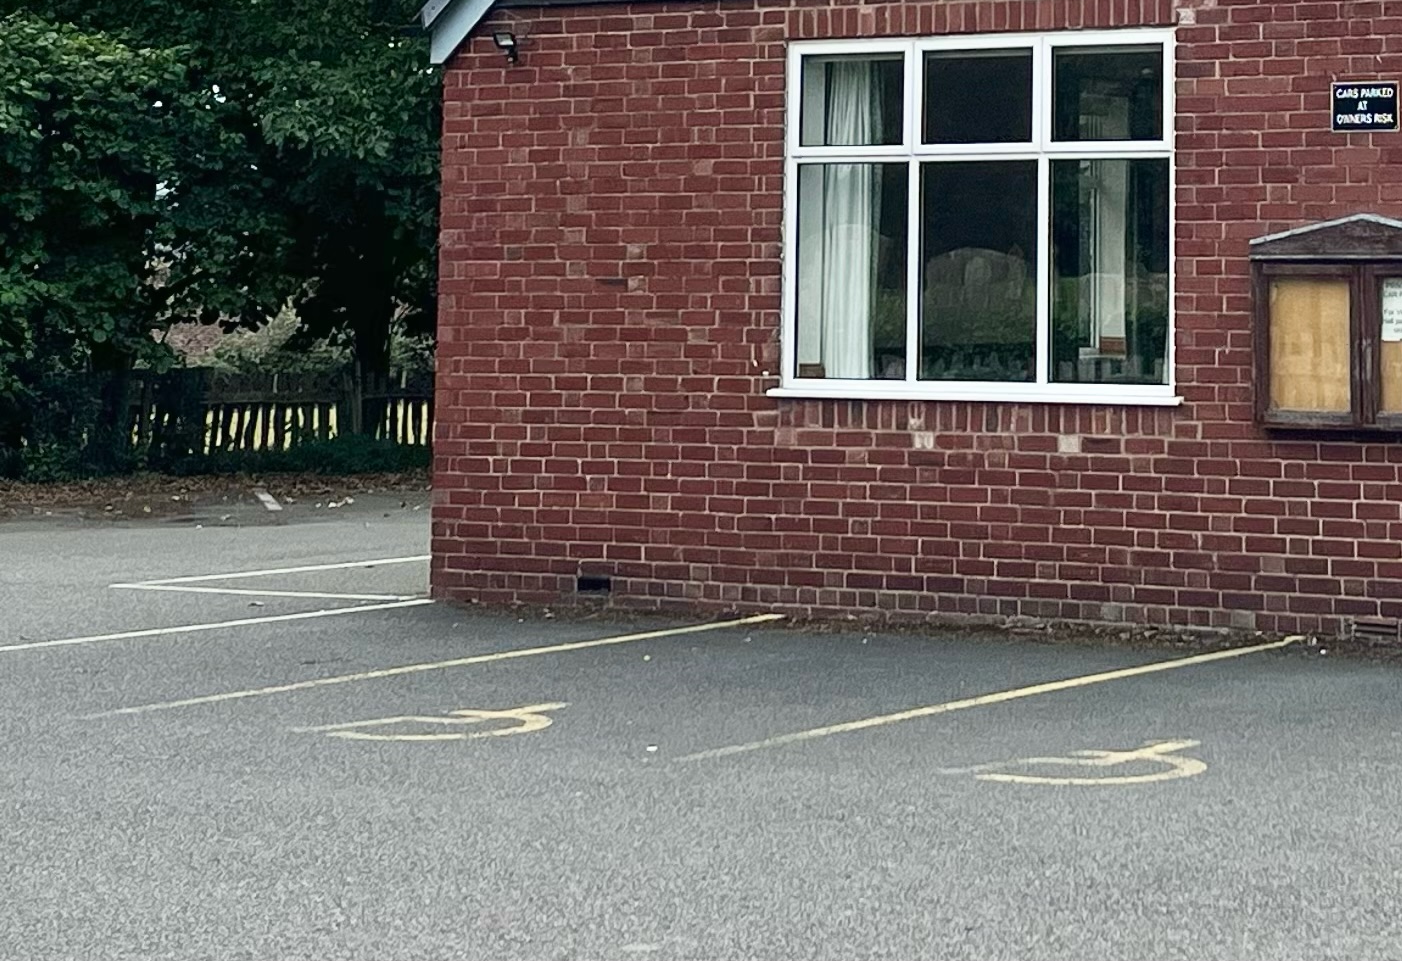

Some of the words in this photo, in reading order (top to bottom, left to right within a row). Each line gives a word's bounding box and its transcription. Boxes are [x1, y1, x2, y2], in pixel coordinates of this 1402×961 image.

[1336, 88, 1358, 98] CARS
[1360, 88, 1394, 98] PARKED
[1357, 100, 1368, 110] AT
[1336, 113, 1372, 124] OWNERS
[1373, 113, 1394, 123] RISK
